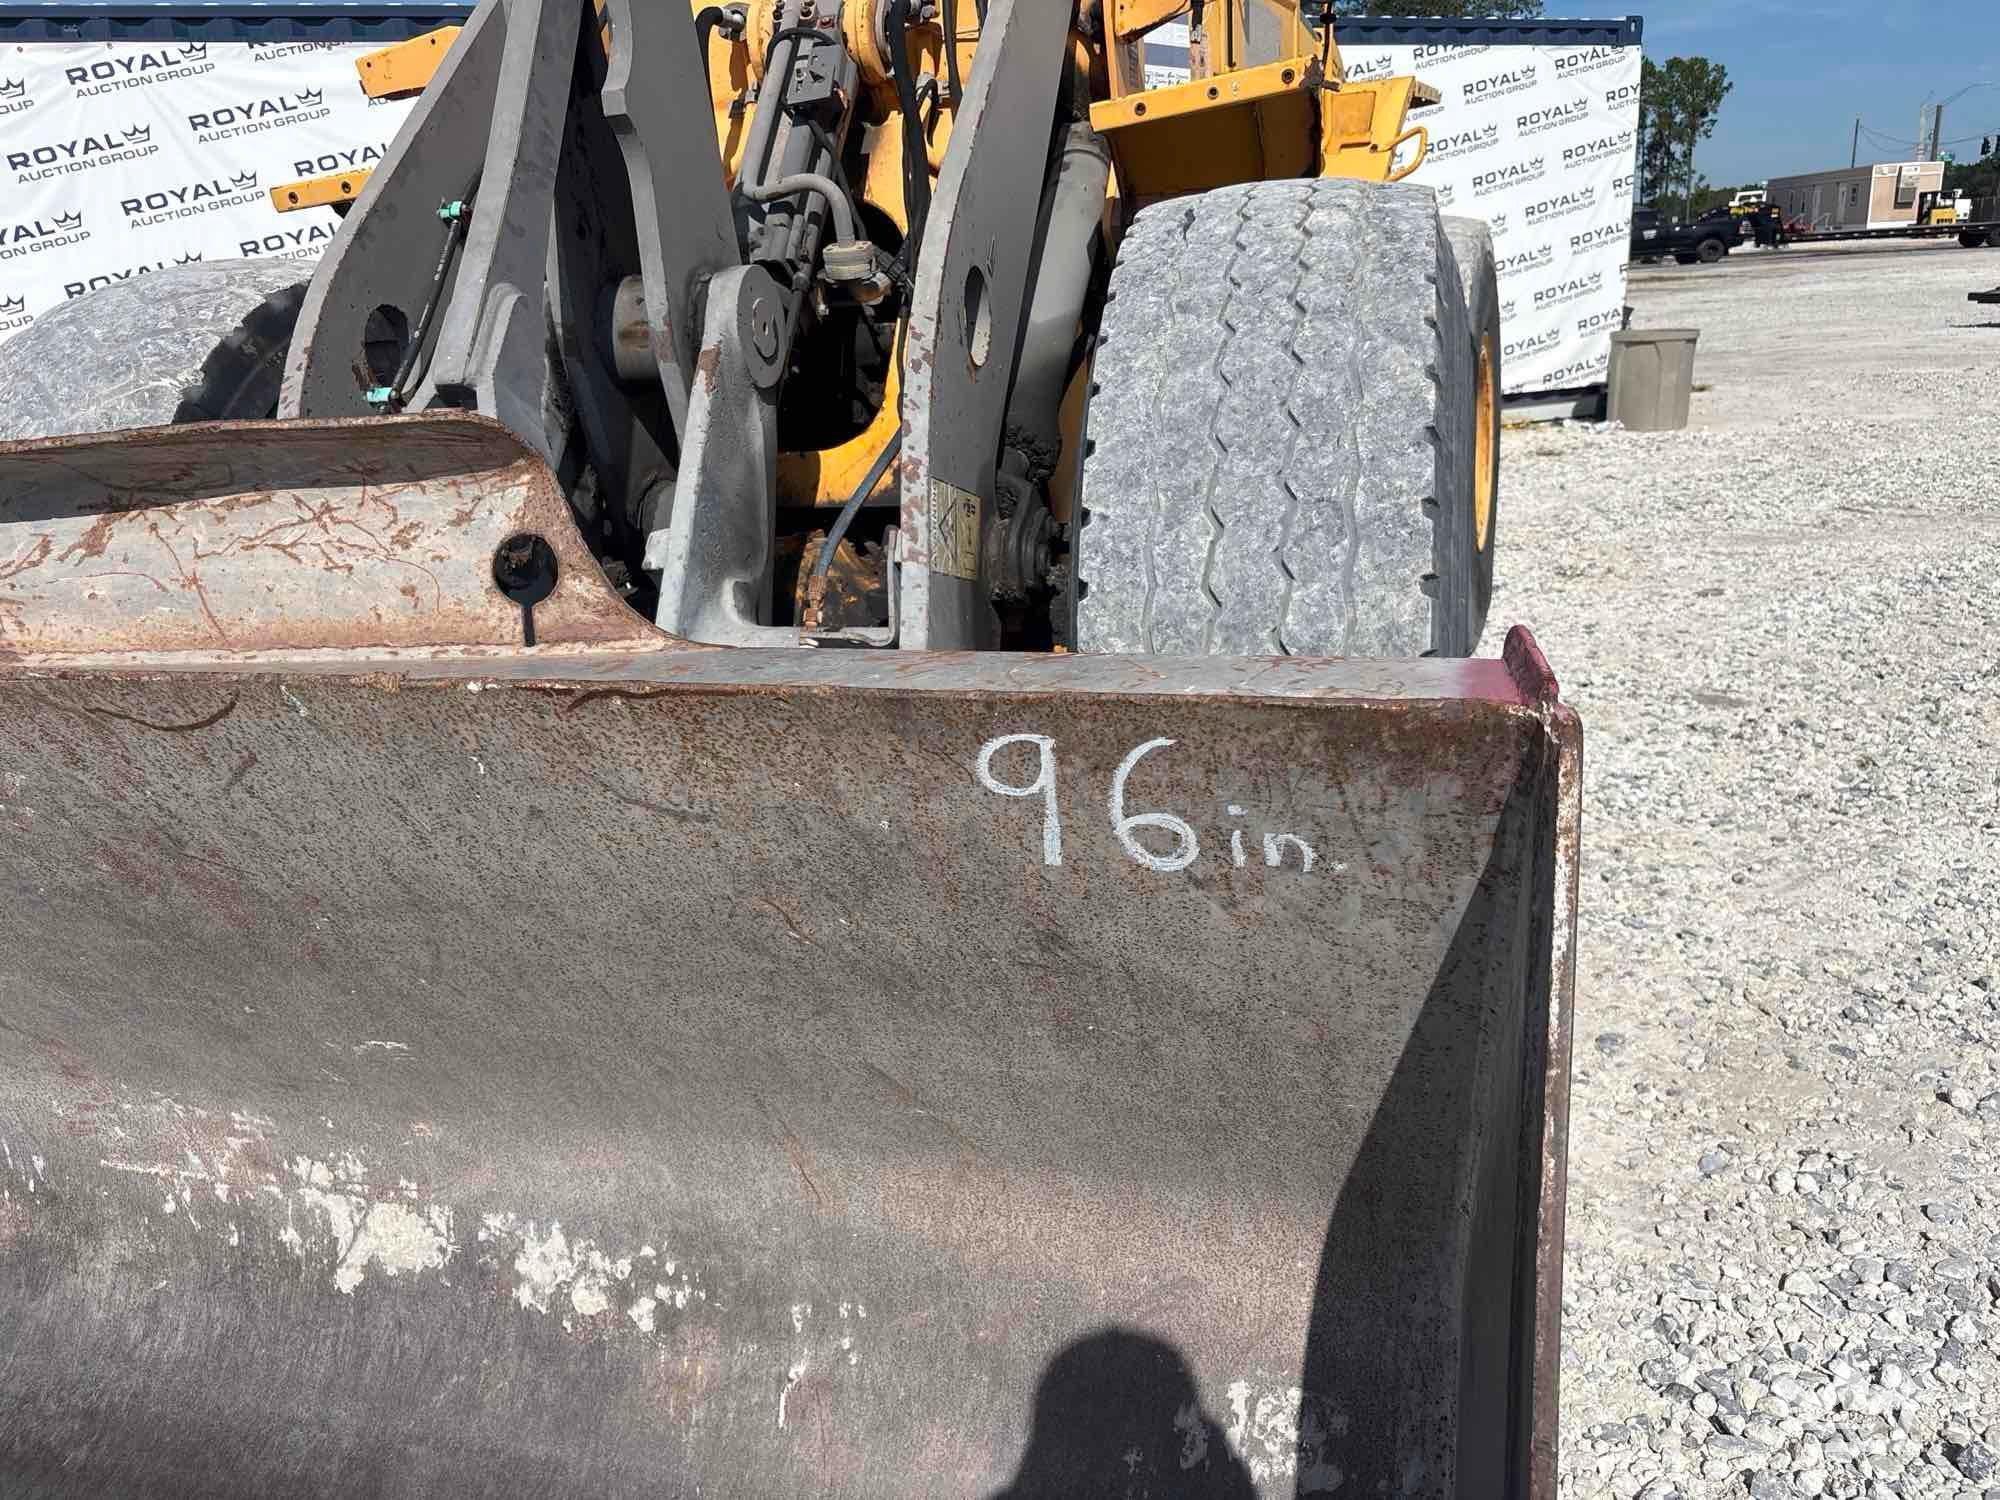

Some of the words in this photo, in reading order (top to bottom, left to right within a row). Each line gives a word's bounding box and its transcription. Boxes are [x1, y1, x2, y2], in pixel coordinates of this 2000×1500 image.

[65, 50, 181, 85] ROYAL
[1344, 61, 1376, 78] YAL
[1415, 54, 1456, 70] AUCTION
[1554, 47, 1610, 70] ROYAL
[1556, 64, 1594, 79] AUCTION
[1595, 55, 1626, 69] GROUP
[75, 74, 153, 99] AUCTION
[155, 63, 216, 83] GROUP
[1463, 72, 1521, 96] ROYAL
[1464, 89, 1505, 105] AUCTION
[1505, 80, 1537, 94] GROUP
[1606, 83, 1640, 102] ROY
[188, 96, 298, 131] ROYAL
[198, 120, 271, 144] AUCTION
[274, 108, 331, 128] GROUP
[1517, 104, 1574, 128] ROYAL
[1518, 120, 1557, 137] AUCTION
[1558, 111, 1589, 126] GROUP
[7, 133, 124, 170] ROYAL
[1424, 129, 1482, 156] ROYAL
[1563, 136, 1617, 161] ROYAL
[18, 158, 96, 184] AUCTION
[100, 144, 160, 165] GROUP
[1425, 148, 1466, 164] AUCTION
[1564, 153, 1601, 170] AUCTION
[1602, 143, 1633, 159] GROUP
[1472, 162, 1529, 188] ROYAL
[1473, 180, 1513, 197] AUCTION
[1514, 170, 1546, 185] GROUP
[120, 180, 232, 216] ROYAL
[131, 204, 205, 229] AUCTION
[207, 190, 265, 211] GROUP
[1525, 192, 1580, 217] ROYAL
[1527, 210, 1565, 226] AUCTION
[1565, 200, 1596, 214] GROUP
[30, 231, 91, 253] GROUP
[1570, 223, 1624, 248] ROYAL
[1572, 240, 1608, 256] AUCTION
[1495, 250, 1538, 272] OYAL
[1534, 277, 1588, 303] ROYAL
[1535, 293, 1573, 311] AUCTION
[1577, 308, 1621, 331] ROYA
[1504, 334, 1546, 356] OYAL
[1543, 359, 1595, 384] ROYAL
